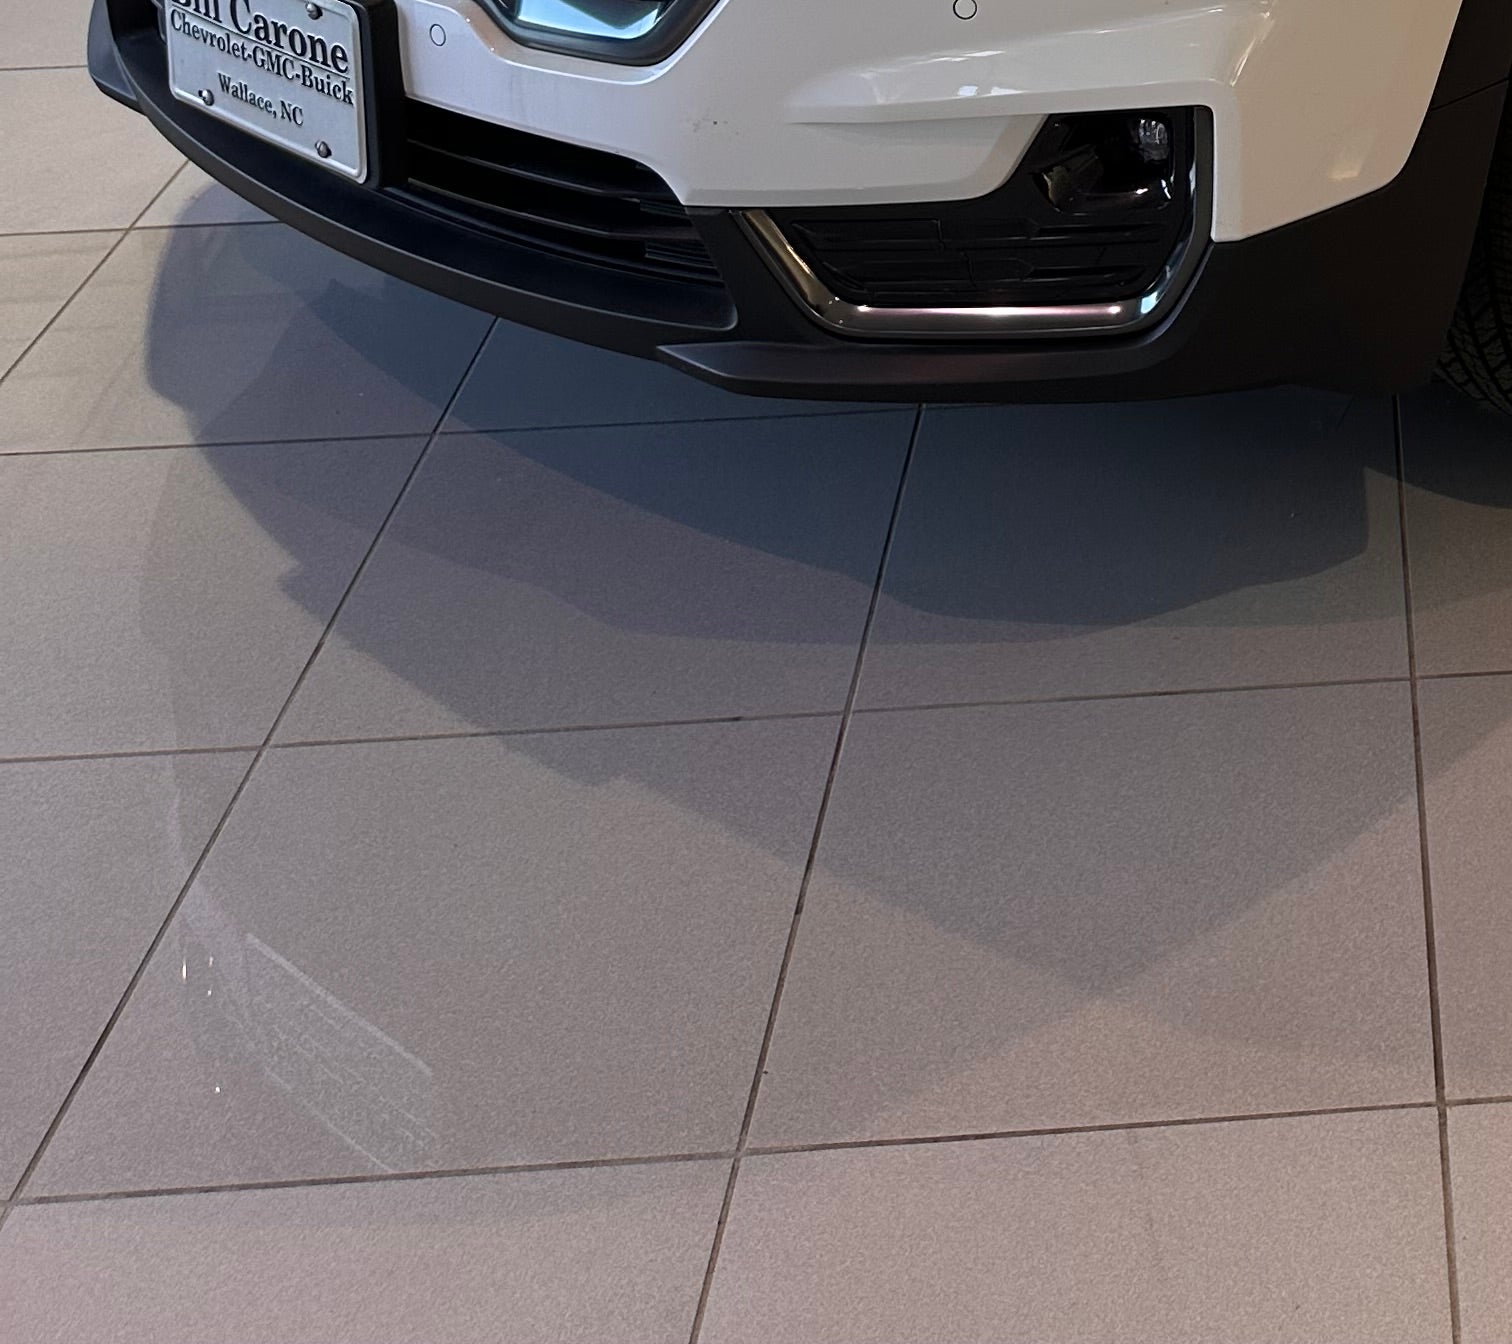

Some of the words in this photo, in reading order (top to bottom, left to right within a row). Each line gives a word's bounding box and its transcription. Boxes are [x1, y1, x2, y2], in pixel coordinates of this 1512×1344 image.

[170, 8, 355, 106] Chevrolet-GMC-Buick
[217, 71, 278, 119] Wallace,
[279, 100, 305, 127] NC
